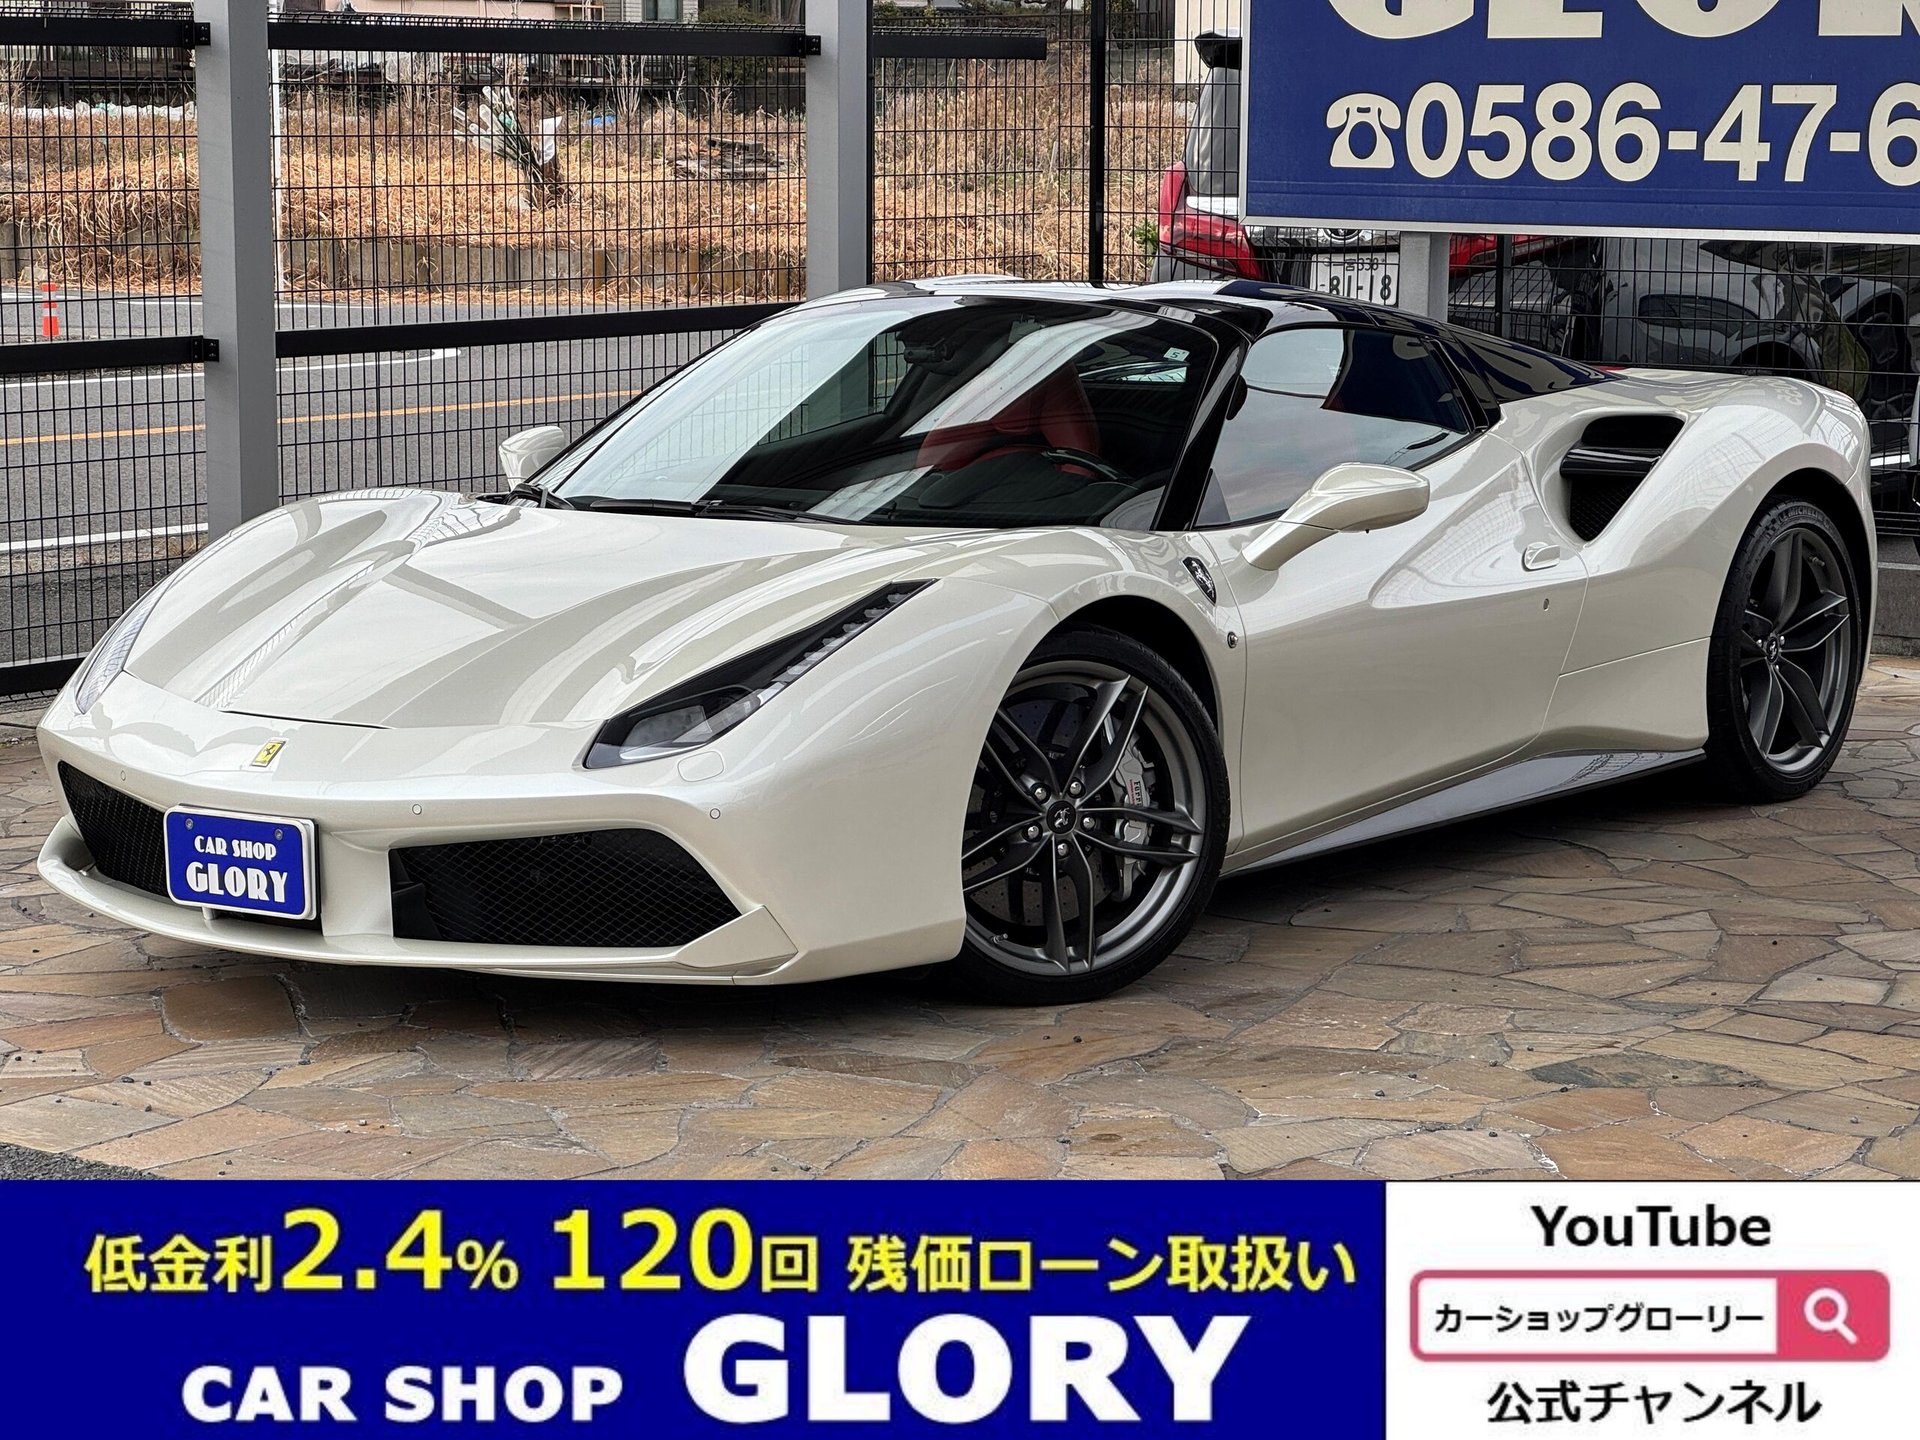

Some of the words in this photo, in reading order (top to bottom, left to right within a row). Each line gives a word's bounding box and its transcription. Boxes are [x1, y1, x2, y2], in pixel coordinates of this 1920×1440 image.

[1406, 82, 1920, 187] 0586-47-6
[194, 836, 228, 856] CAR
[232, 840, 277, 861] SHOP
[185, 861, 288, 903] GLORY
